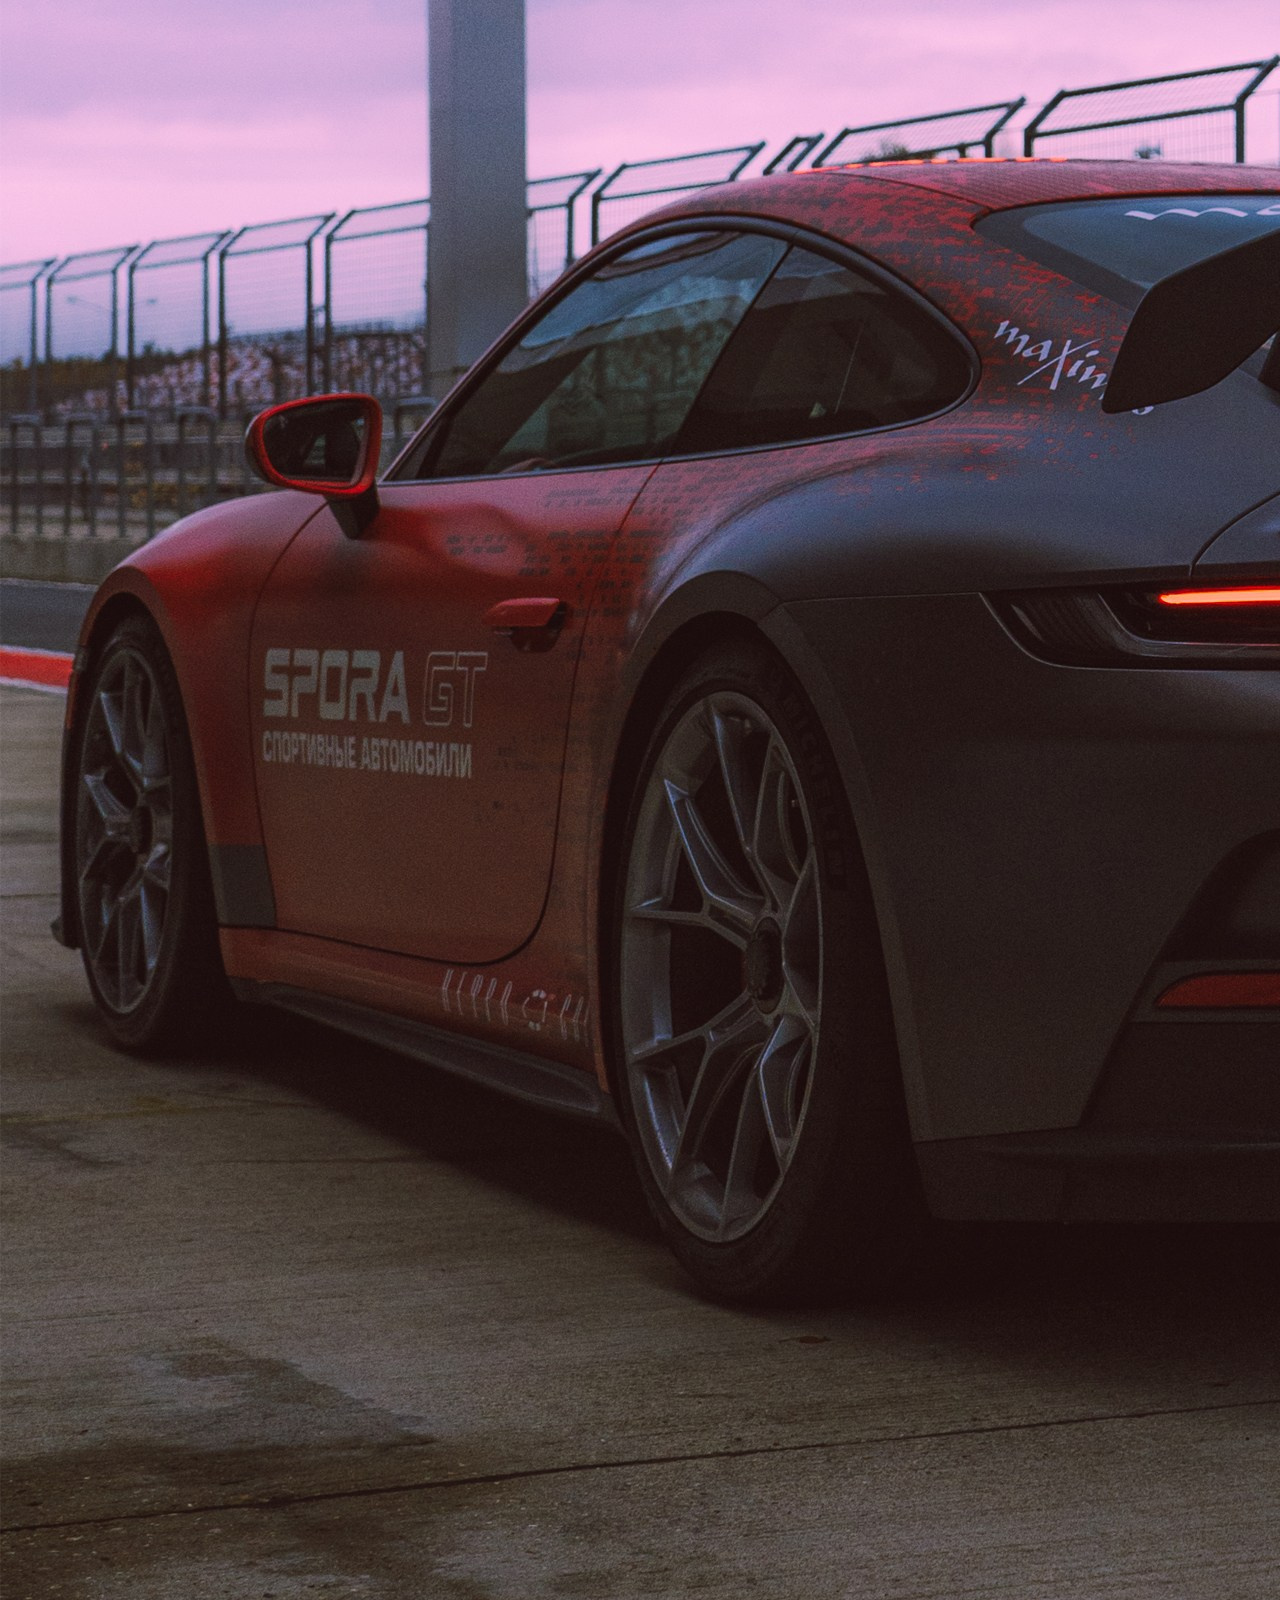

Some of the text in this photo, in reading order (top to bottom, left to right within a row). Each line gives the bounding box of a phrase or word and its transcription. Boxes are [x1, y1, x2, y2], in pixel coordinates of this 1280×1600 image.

[263, 648, 411, 724] SPORA
[423, 650, 488, 728] GT
[262, 730, 473, 779] СПОРТИВНЫЕ АВТОМОБИЛИ
